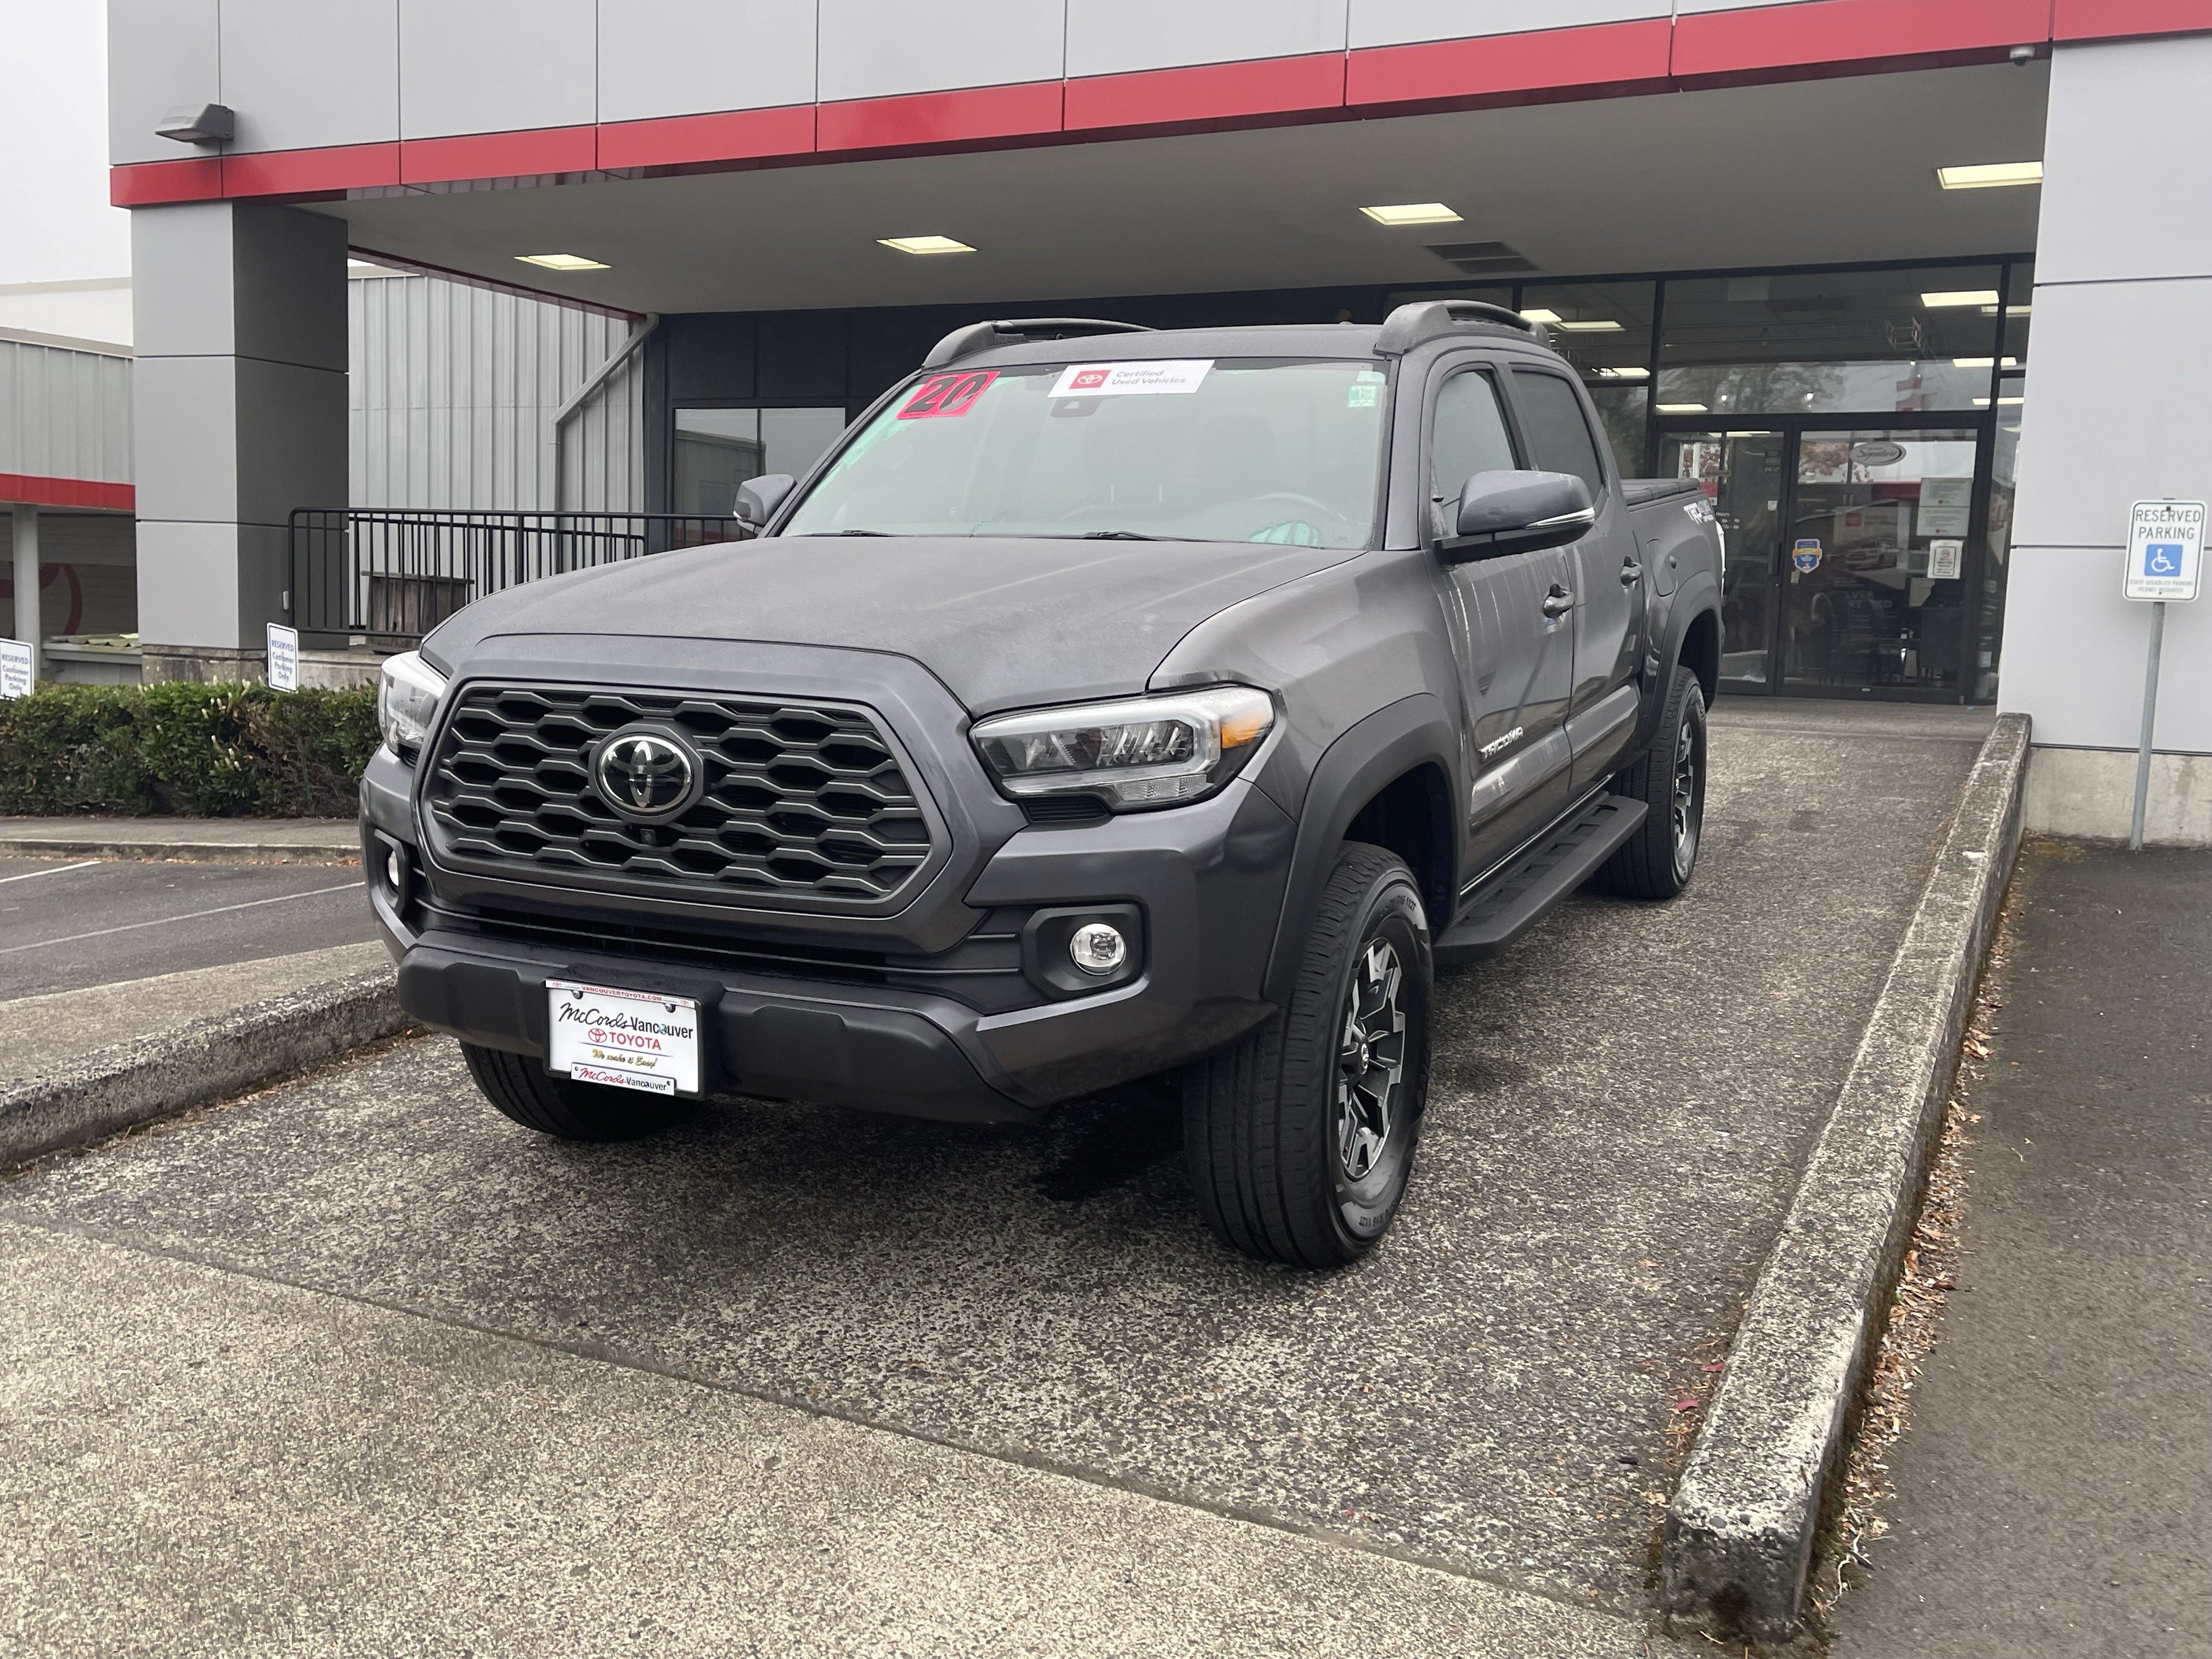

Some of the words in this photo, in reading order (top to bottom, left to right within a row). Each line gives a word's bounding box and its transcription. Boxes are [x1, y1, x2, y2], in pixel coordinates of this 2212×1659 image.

[904, 374, 988, 413] 20
[2135, 509, 2201, 522] RESERVED
[2138, 527, 2194, 539] PARKING
[272, 640, 294, 652] RESERVED
[2, 654, 29, 664] RESERVED
[275, 662, 292, 675] Parking
[5, 674, 26, 685] Parking
[278, 672, 289, 682] Only
[9, 682, 22, 692] Only
[1479, 726, 1524, 759] TACOMA
[582, 985, 662, 1001] VANCOUVERTOYOTA.COM
[609, 1031, 662, 1051] TOYOTA
[592, 1048, 605, 1059] We
[606, 1054, 625, 1063] make
